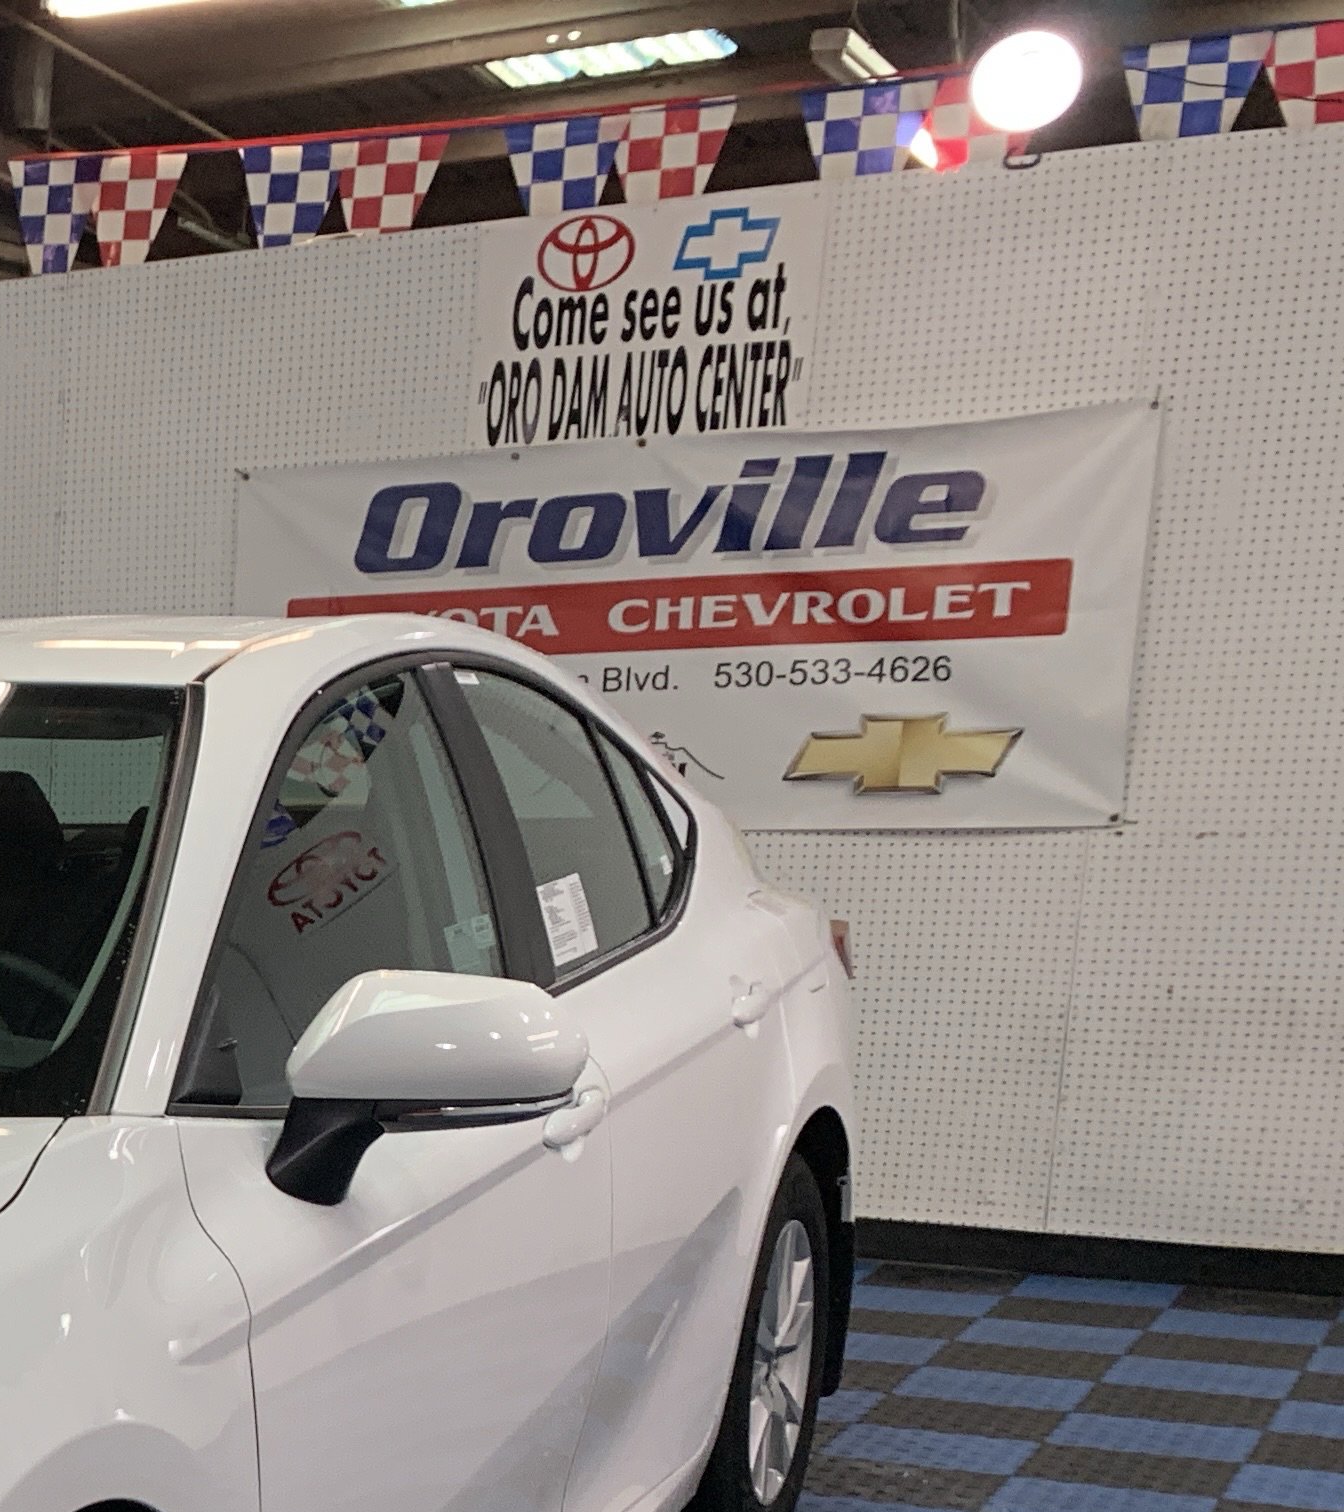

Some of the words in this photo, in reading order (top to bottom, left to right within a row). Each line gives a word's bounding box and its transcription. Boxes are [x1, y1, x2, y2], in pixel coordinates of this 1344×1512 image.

[513, 276, 609, 351] Come
[620, 286, 682, 343] see
[694, 280, 735, 336] us
[747, 262, 791, 335] at,
[547, 353, 610, 442] DAM
[613, 345, 689, 437] AUTO
[354, 451, 988, 574] Oroville
[608, 581, 1031, 634] CHEVROLET
[602, 665, 679, 693] Blvd.
[714, 655, 952, 689] 530-533-4626
